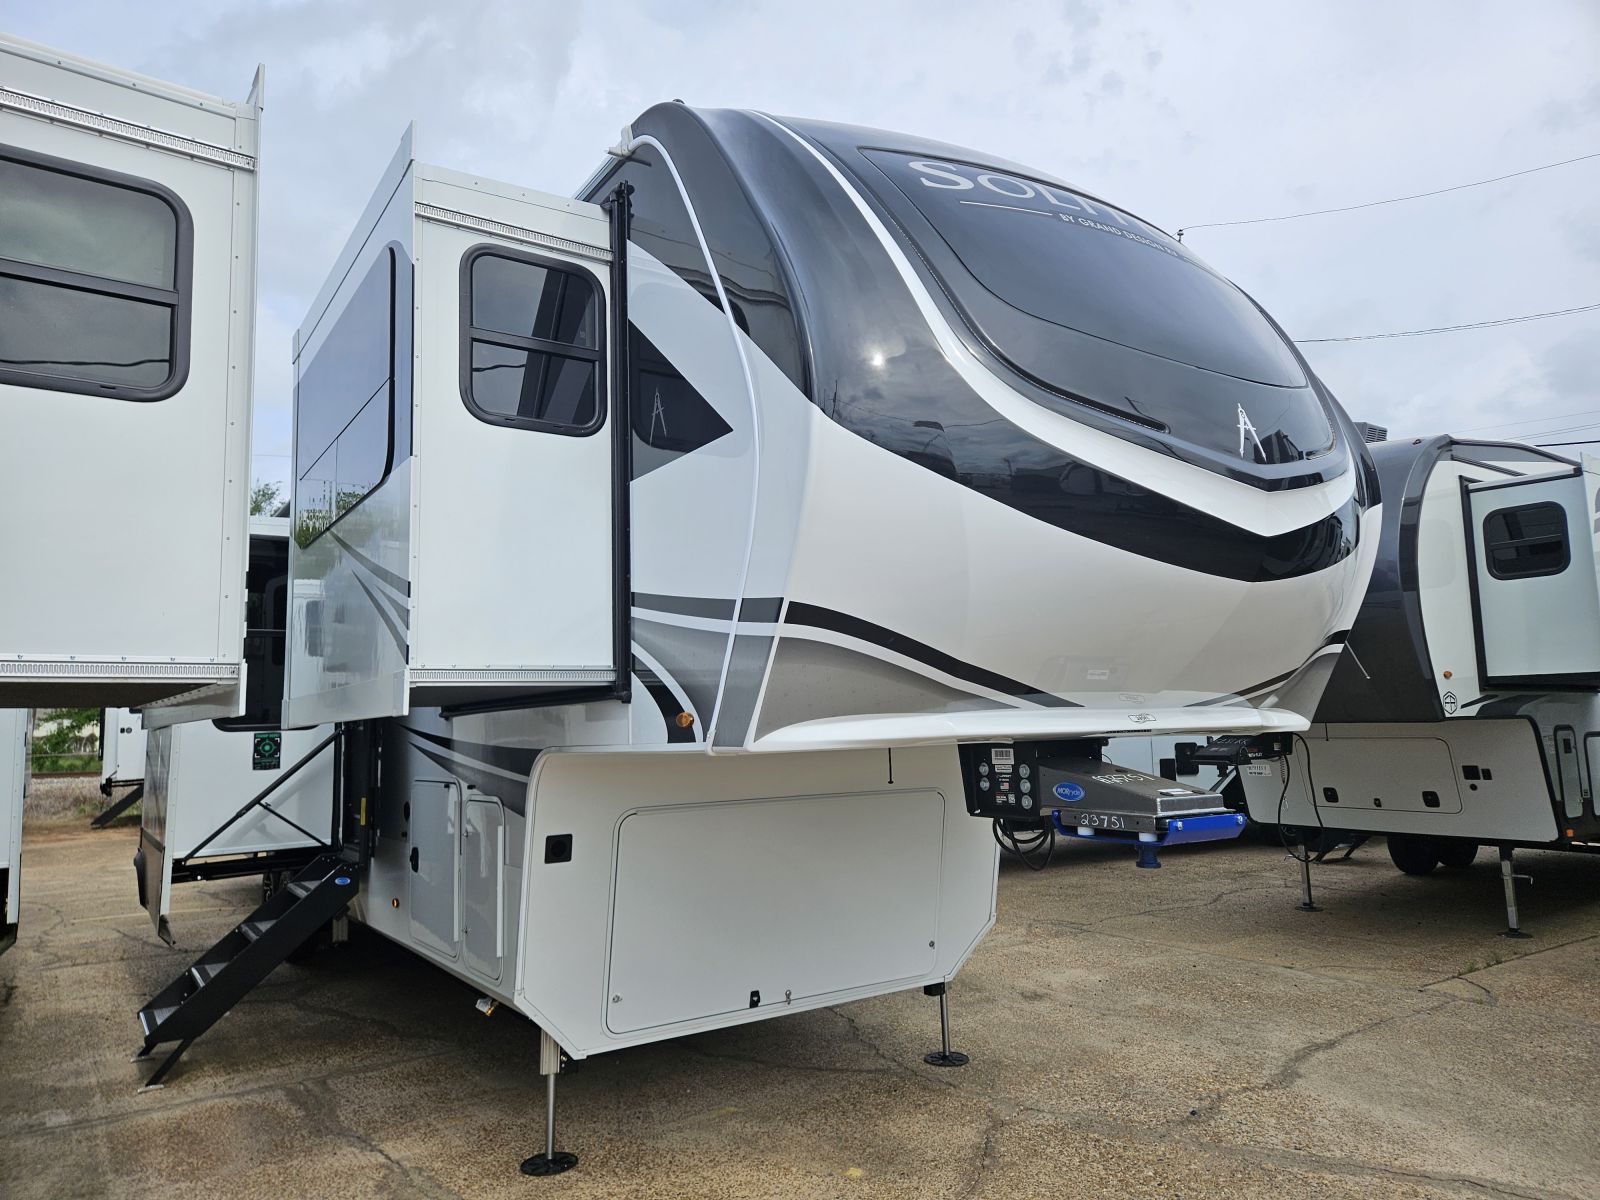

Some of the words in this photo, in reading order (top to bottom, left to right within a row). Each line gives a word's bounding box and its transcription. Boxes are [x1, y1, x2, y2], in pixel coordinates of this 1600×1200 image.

[1059, 213, 1076, 223] BY
[1078, 218, 1122, 235] GRAND
[1080, 813, 1125, 829] 23751
